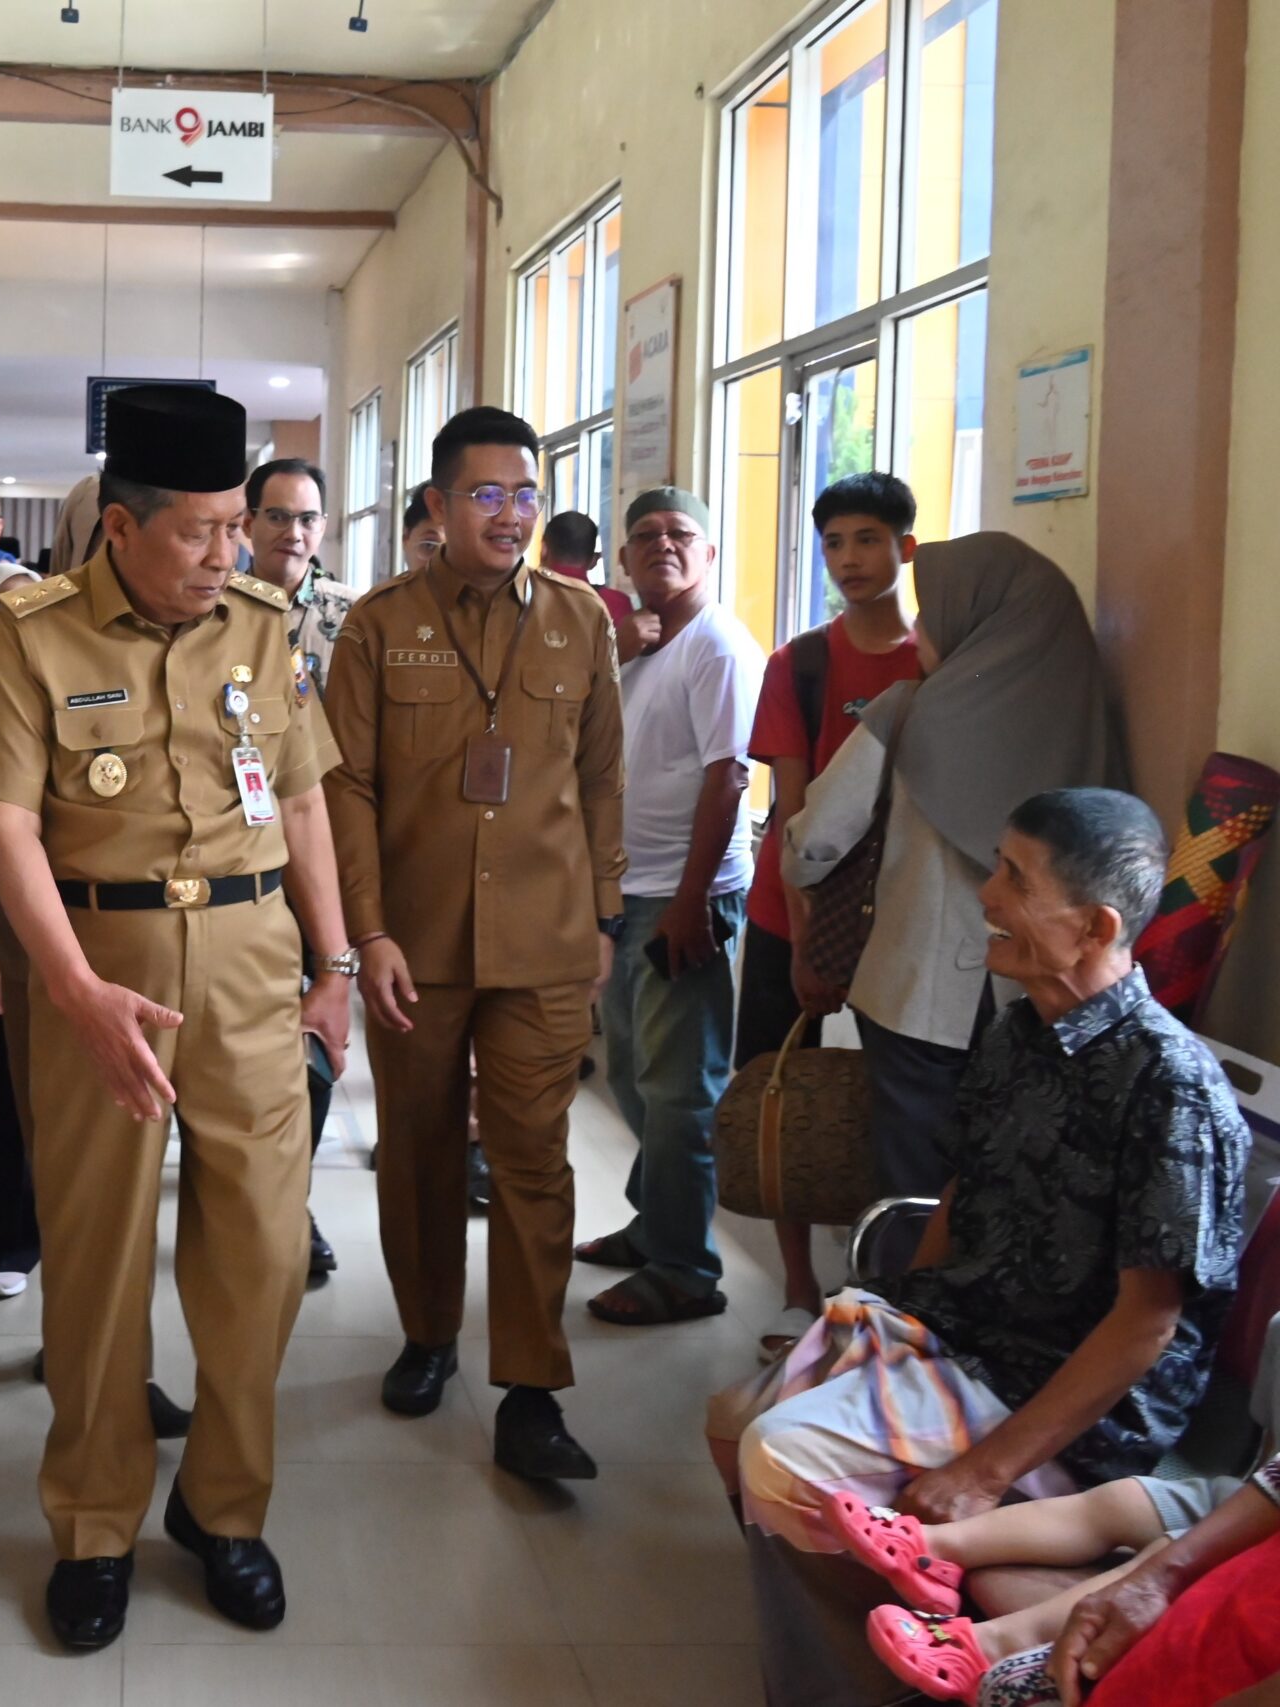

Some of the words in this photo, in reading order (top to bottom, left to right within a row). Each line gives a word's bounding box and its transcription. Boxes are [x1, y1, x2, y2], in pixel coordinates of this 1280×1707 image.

[120, 116, 172, 134] BANK
[207, 120, 265, 138] JAMBI
[397, 652, 447, 664] FERDI
